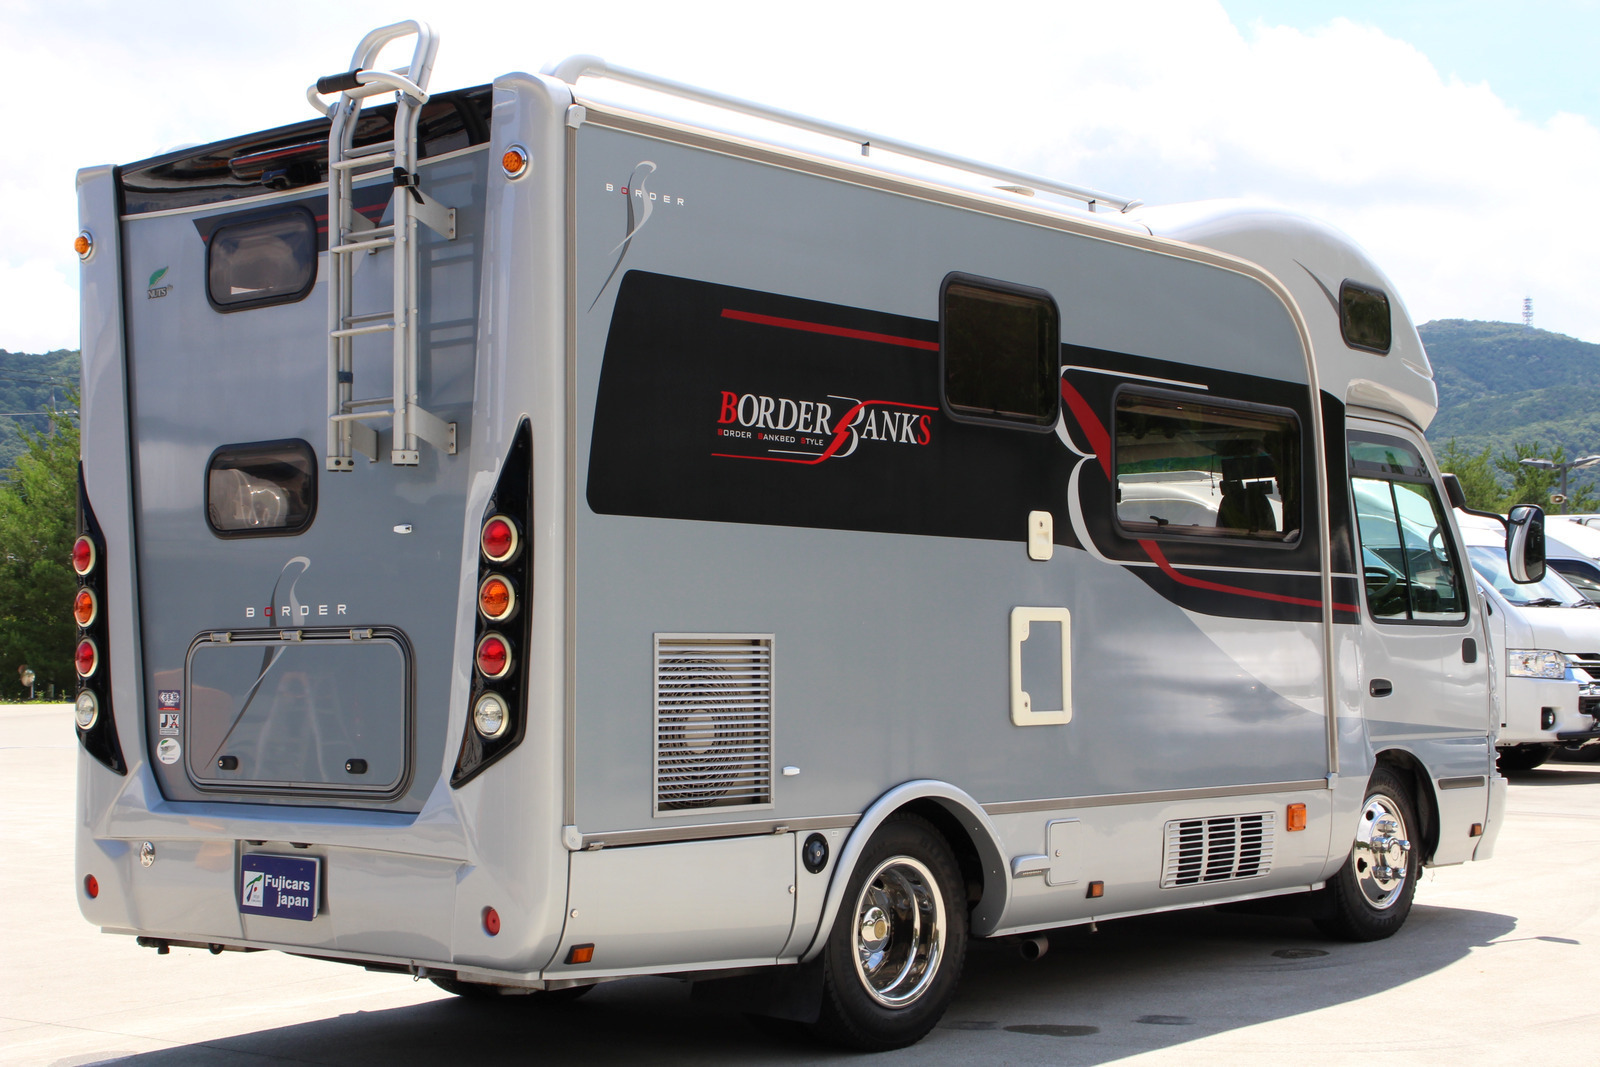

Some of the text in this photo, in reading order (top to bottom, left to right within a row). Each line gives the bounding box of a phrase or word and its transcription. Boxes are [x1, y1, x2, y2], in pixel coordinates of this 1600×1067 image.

[605, 183, 685, 206] BORDER
[717, 390, 932, 459] BORDER BANKS
[717, 428, 824, 446] BORDER BANKBED STYLE
[245, 604, 347, 618] BORDER
[264, 874, 311, 892] Fujicars
[276, 891, 309, 909] japan
